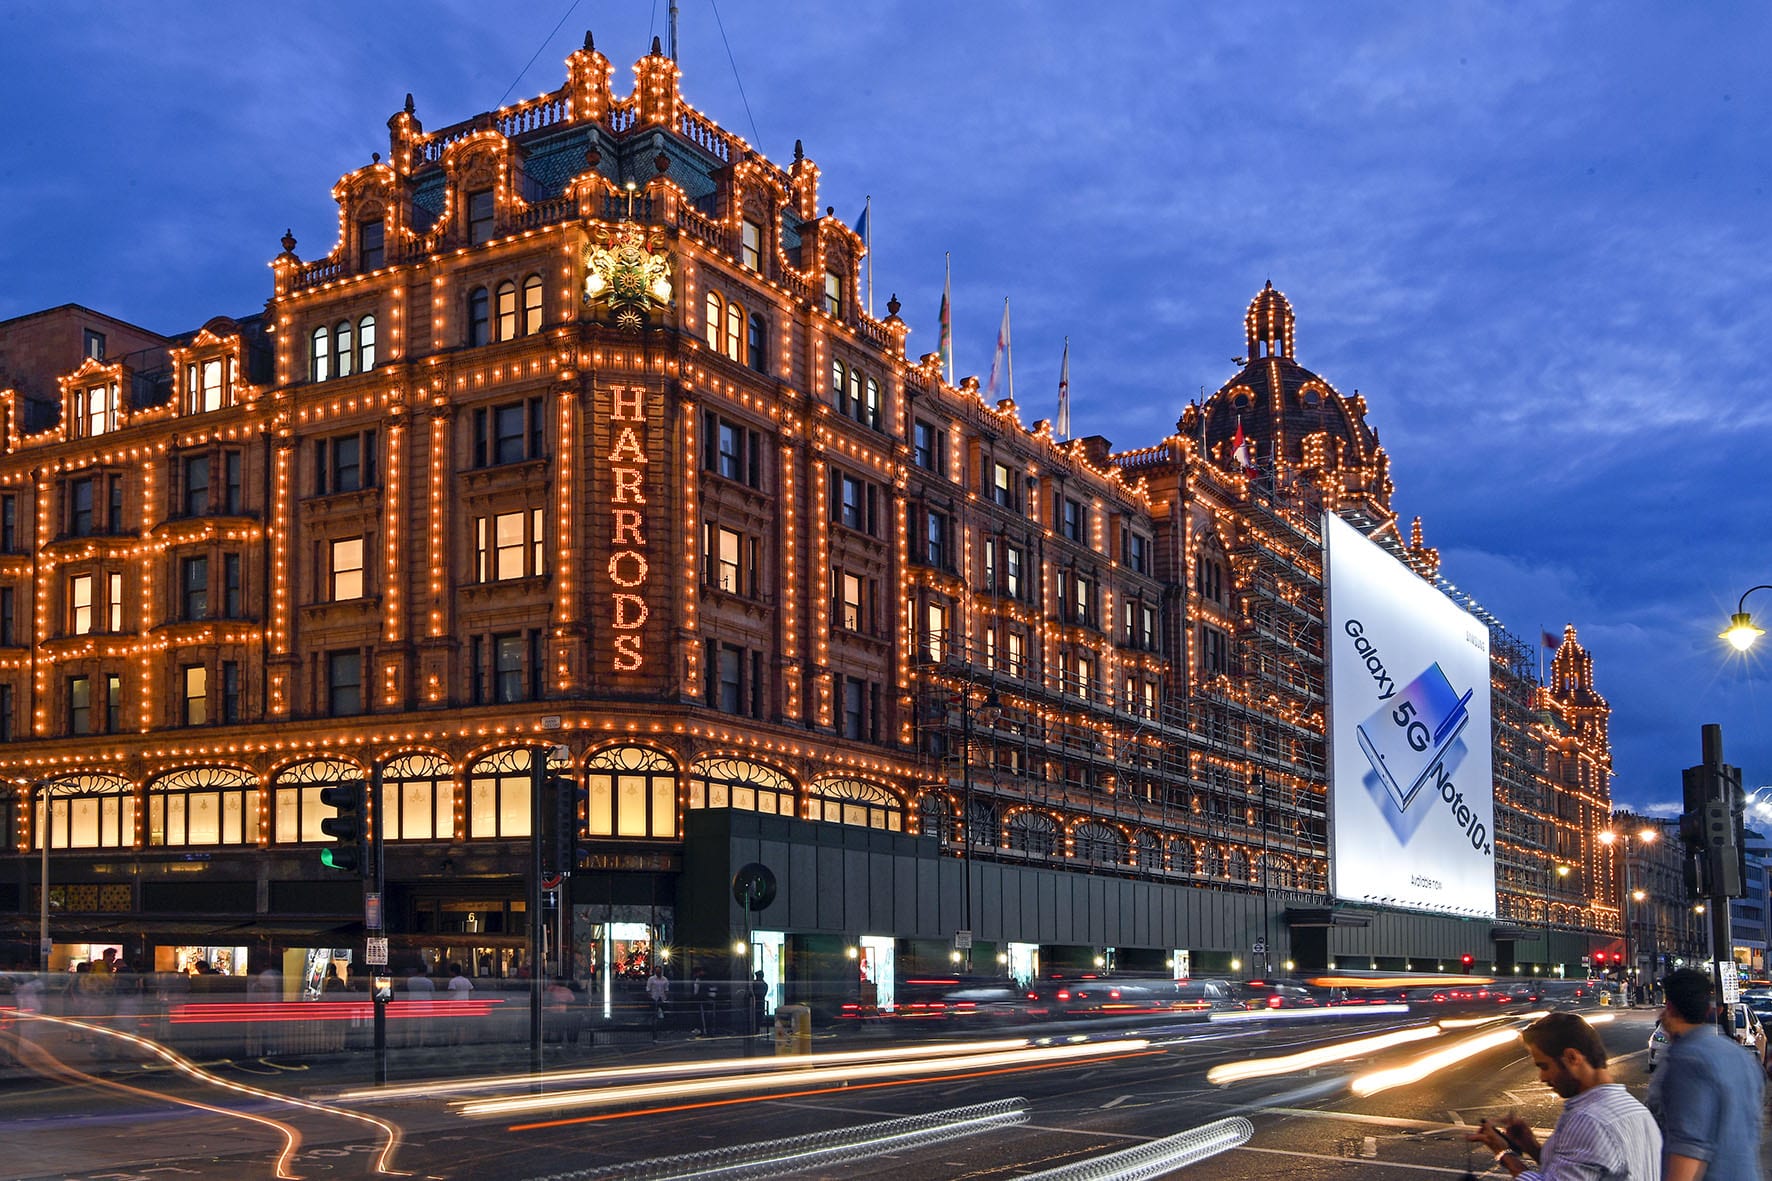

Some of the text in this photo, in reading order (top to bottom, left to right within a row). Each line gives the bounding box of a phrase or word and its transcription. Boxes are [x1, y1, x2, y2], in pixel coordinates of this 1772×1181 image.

[608, 385, 648, 671] HARRODS
[1344, 619, 1396, 701] Galaxy
[1393, 700, 1430, 752] 5G
[1430, 762, 1491, 856] Note10+
[468, 912, 475, 922] 6
